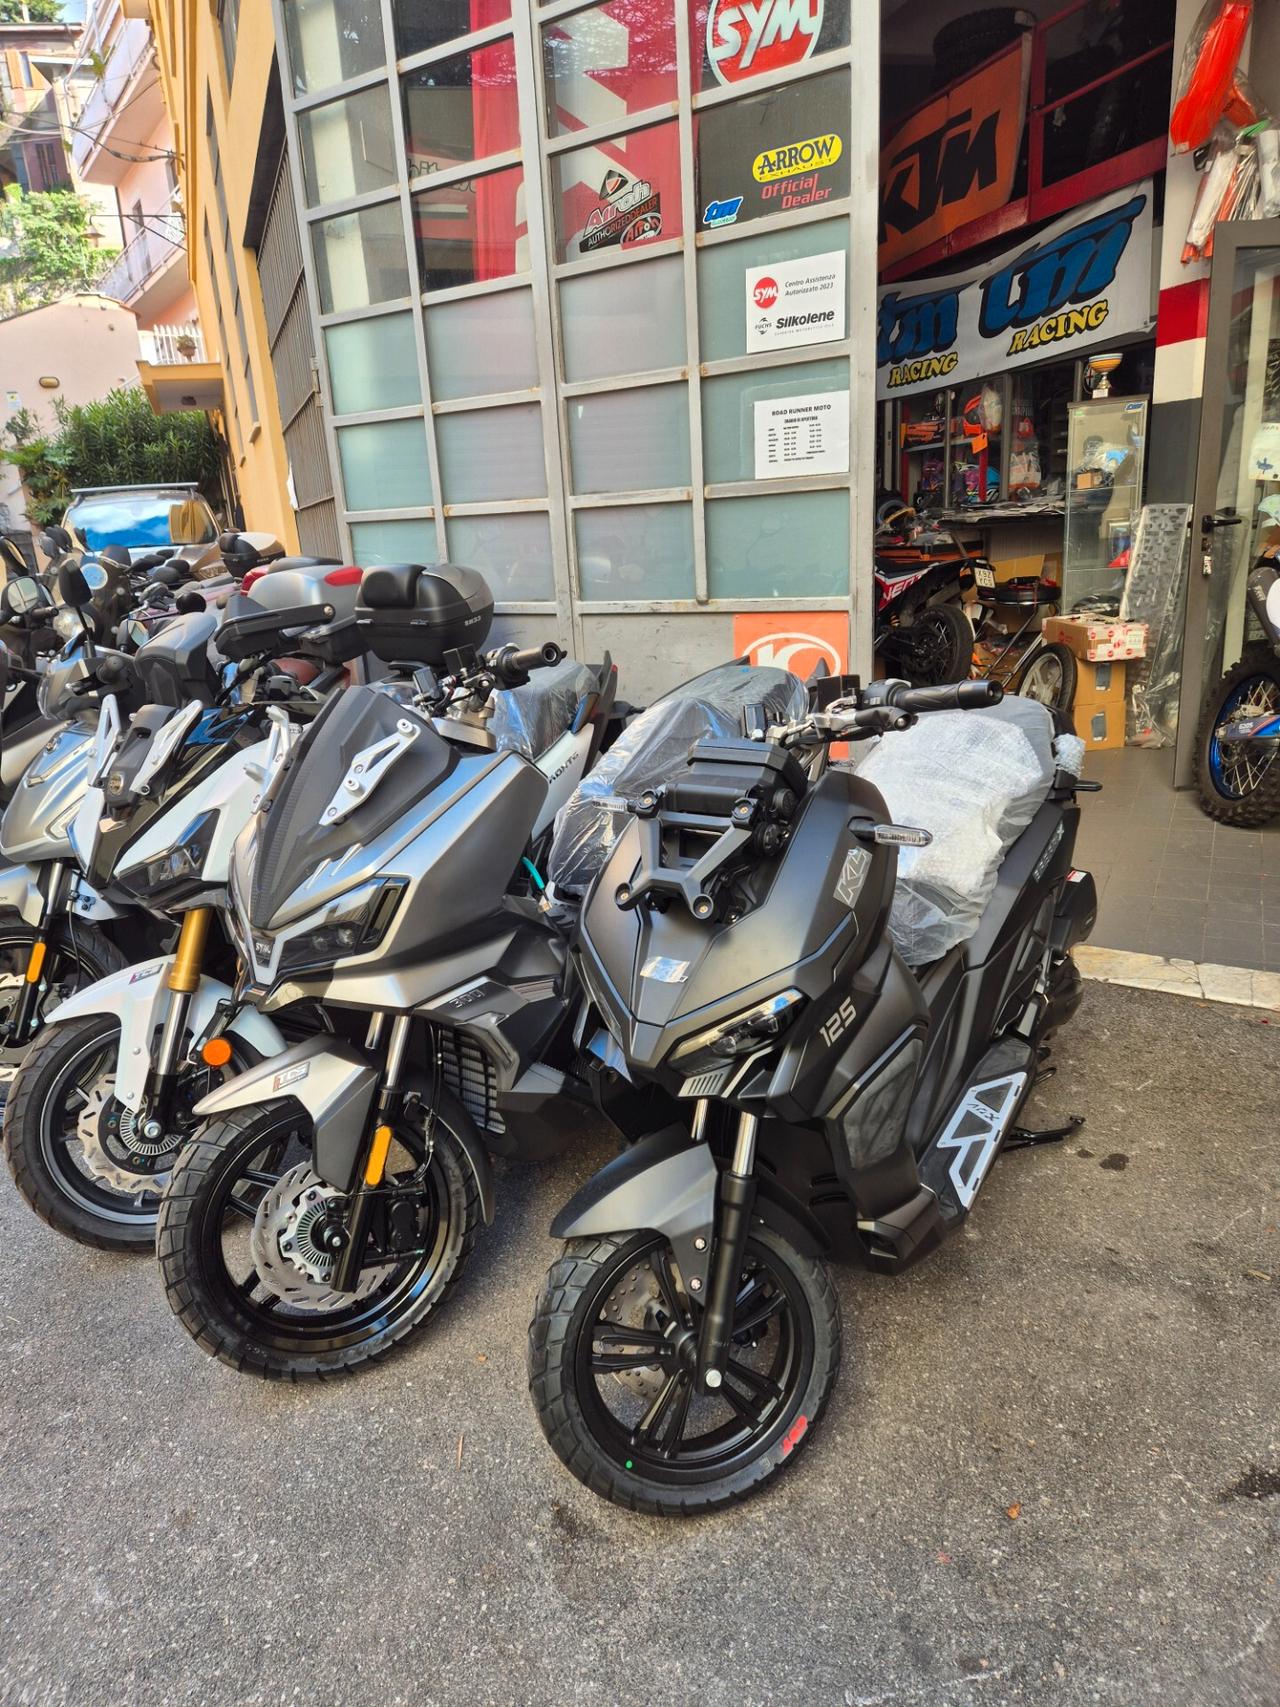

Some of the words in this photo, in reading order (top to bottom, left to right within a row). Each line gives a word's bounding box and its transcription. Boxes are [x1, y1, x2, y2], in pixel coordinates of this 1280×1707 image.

[711, 0, 822, 69] SYM
[757, 136, 836, 175] ARROW
[761, 173, 819, 200] Official
[878, 108, 1000, 242] KTM
[781, 186, 833, 209] Dealer
[784, 279, 805, 288] Centro
[805, 273, 836, 284] Assistenza
[784, 286, 819, 297] Autorizzato
[753, 285, 778, 304] SYM
[776, 310, 835, 329] Silkolene
[1006, 299, 1109, 356] RACING
[886, 351, 958, 388] RACING
[788, 406, 813, 415] RUNNER
[813, 404, 832, 412] MOTO
[819, 996, 857, 1048] 125
